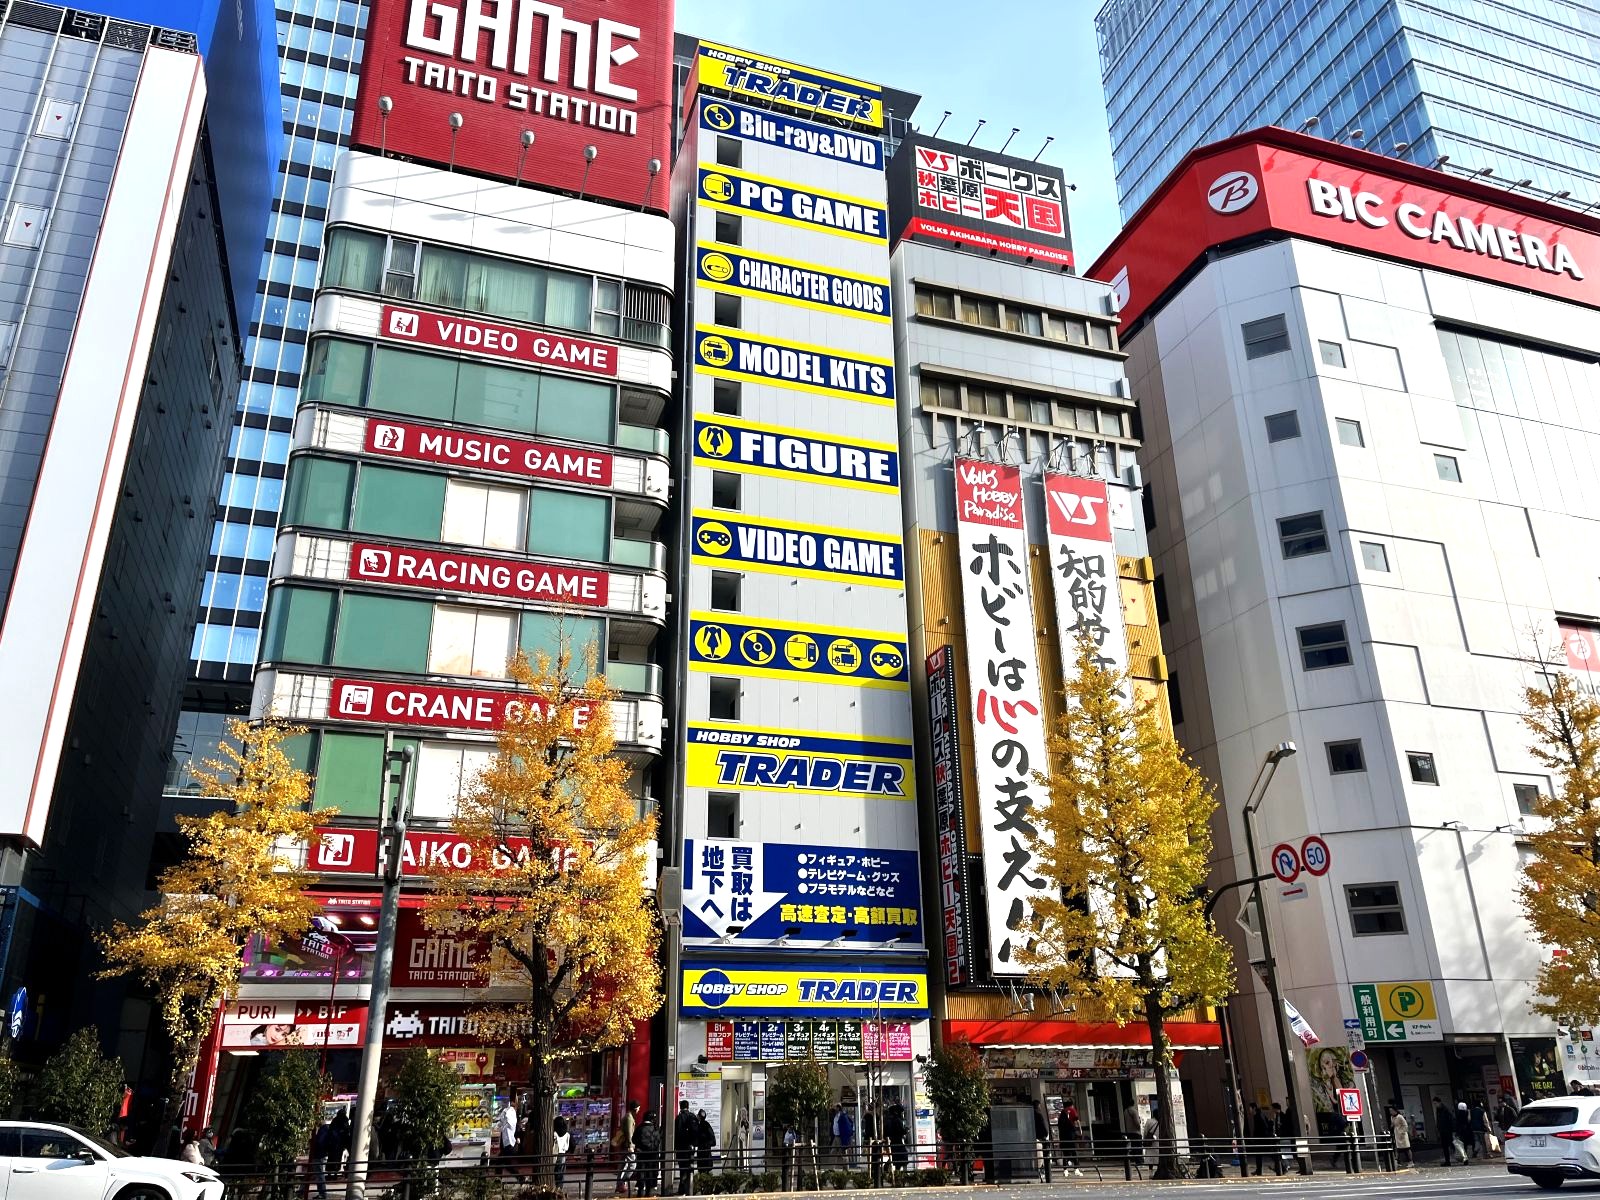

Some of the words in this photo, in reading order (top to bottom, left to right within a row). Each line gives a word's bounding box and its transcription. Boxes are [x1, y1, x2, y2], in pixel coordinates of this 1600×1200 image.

[406, 0, 640, 102] GAME
[707, 49, 752, 66] HOBBY
[756, 60, 791, 75] SHOP
[404, 56, 497, 102] TAITO
[508, 82, 637, 135] STATION
[723, 65, 874, 122] TRADER
[740, 110, 876, 164] Blu-ray&DVD
[918, 171, 981, 199] 秋葉原
[960, 160, 1060, 199] ボークス
[740, 180, 784, 213] PC
[791, 193, 880, 235] GAME
[919, 191, 981, 213] ホビー
[983, 187, 1063, 234] 天国
[920, 223, 949, 235] VOLKS
[949, 230, 998, 246] AKIHABARA
[999, 241, 1027, 253] HOBBY
[1028, 247, 1068, 261] PARADISE
[1307, 177, 1389, 228] BIC
[1398, 202, 1585, 280] CAMERA
[739, 258, 829, 302] CHARACTER
[832, 278, 883, 313] GOODS
[437, 320, 518, 352] VIDEO
[533, 338, 608, 368] GAME
[739, 342, 825, 384] MODEL
[830, 360, 887, 395] KITS
[419, 434, 510, 465] MUSIC
[524, 449, 602, 479] GAME
[740, 431, 891, 483] FIGURE
[737, 526, 817, 566] VIDEO
[823, 538, 895, 576] GAME
[397, 555, 510, 588] RACING
[517, 569, 598, 598] GAME
[385, 690, 493, 722] CRANE
[695, 731, 753, 746] HOBBY
[756, 735, 801, 749] SHOP
[716, 750, 906, 796] TRADER
[1306, 847, 1325, 866] 50
[701, 845, 725, 919] 地下へ
[731, 846, 753, 922] 買取は
[301, 946, 329, 960] STATION
[302, 937, 333, 955] TAITO
[409, 938, 477, 968] GAME
[409, 970, 434, 980] TAITO
[691, 982, 743, 996] HOBBY
[745, 983, 788, 996] SHOP
[797, 978, 920, 1004] TRADER
[238, 1005, 277, 1019] PURI
[318, 1005, 347, 1019] B1F
[742, 1023, 752, 1032] 1F
[767, 1023, 779, 1032] 2F
[793, 1023, 804, 1032] 3F
[819, 1023, 830, 1032] 4F
[844, 1023, 855, 1032] 5F
[1359, 989, 1378, 1039] 一般利用可
[1072, 1069, 1082, 1078] 2F
